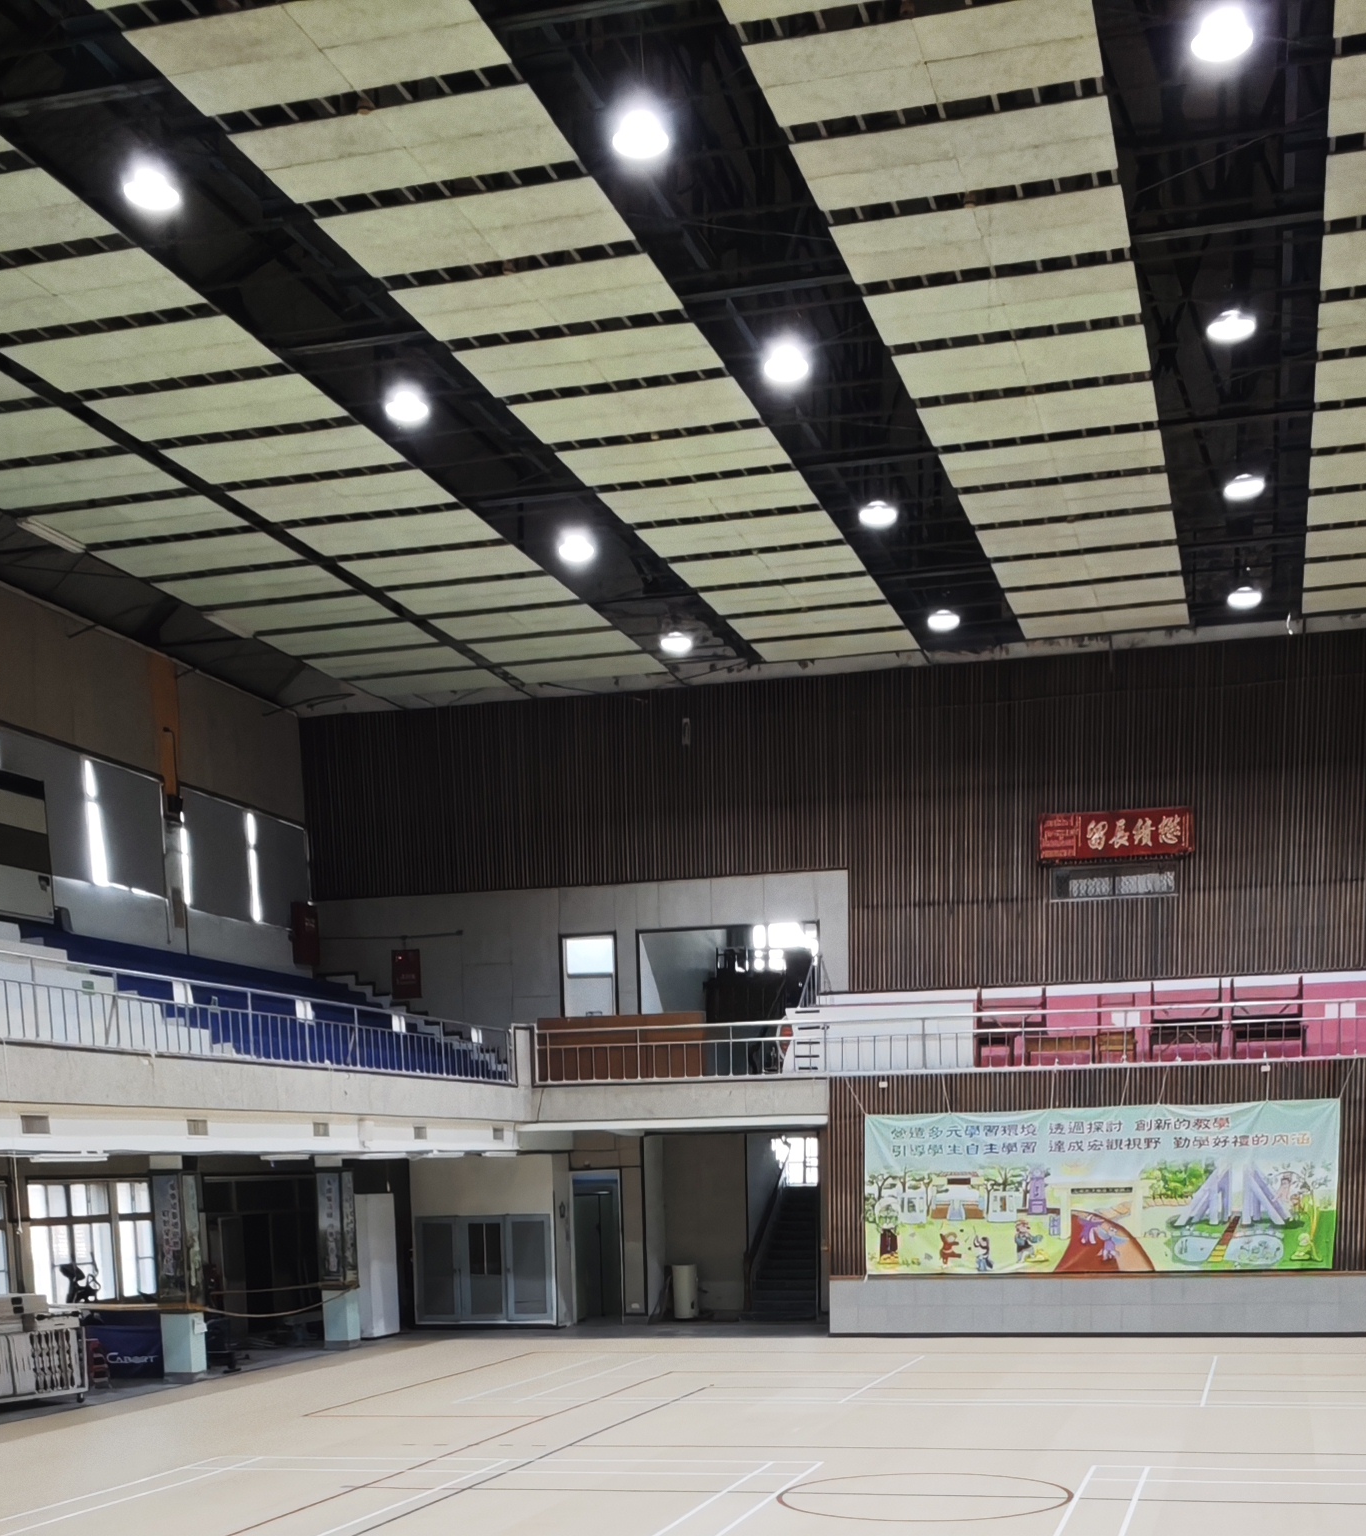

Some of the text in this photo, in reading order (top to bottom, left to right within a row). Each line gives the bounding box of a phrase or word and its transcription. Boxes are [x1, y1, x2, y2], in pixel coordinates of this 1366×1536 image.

[1135, 1117, 1230, 1132] 創新的教學
